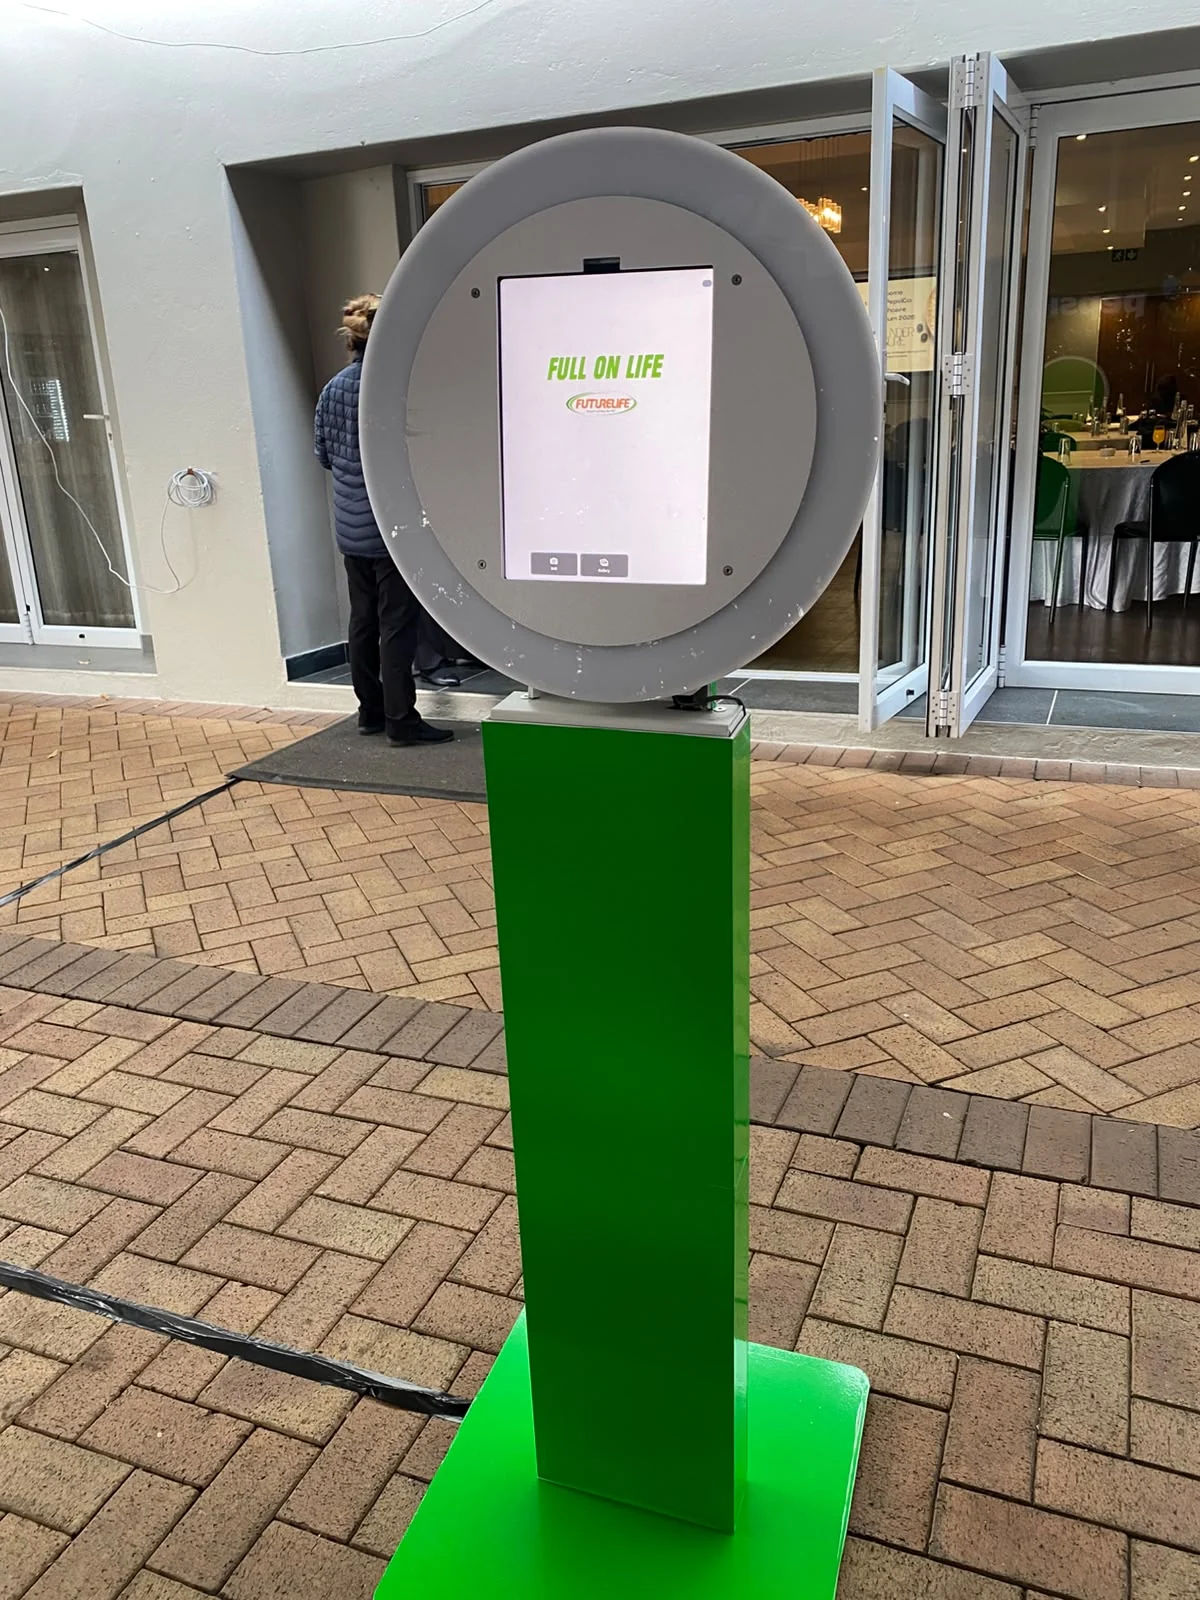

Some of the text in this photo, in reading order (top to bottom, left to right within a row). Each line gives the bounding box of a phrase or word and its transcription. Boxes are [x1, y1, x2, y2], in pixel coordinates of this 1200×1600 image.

[547, 353, 665, 380] FULL ON LIFE
[575, 398, 631, 409] FUTURELIFE
